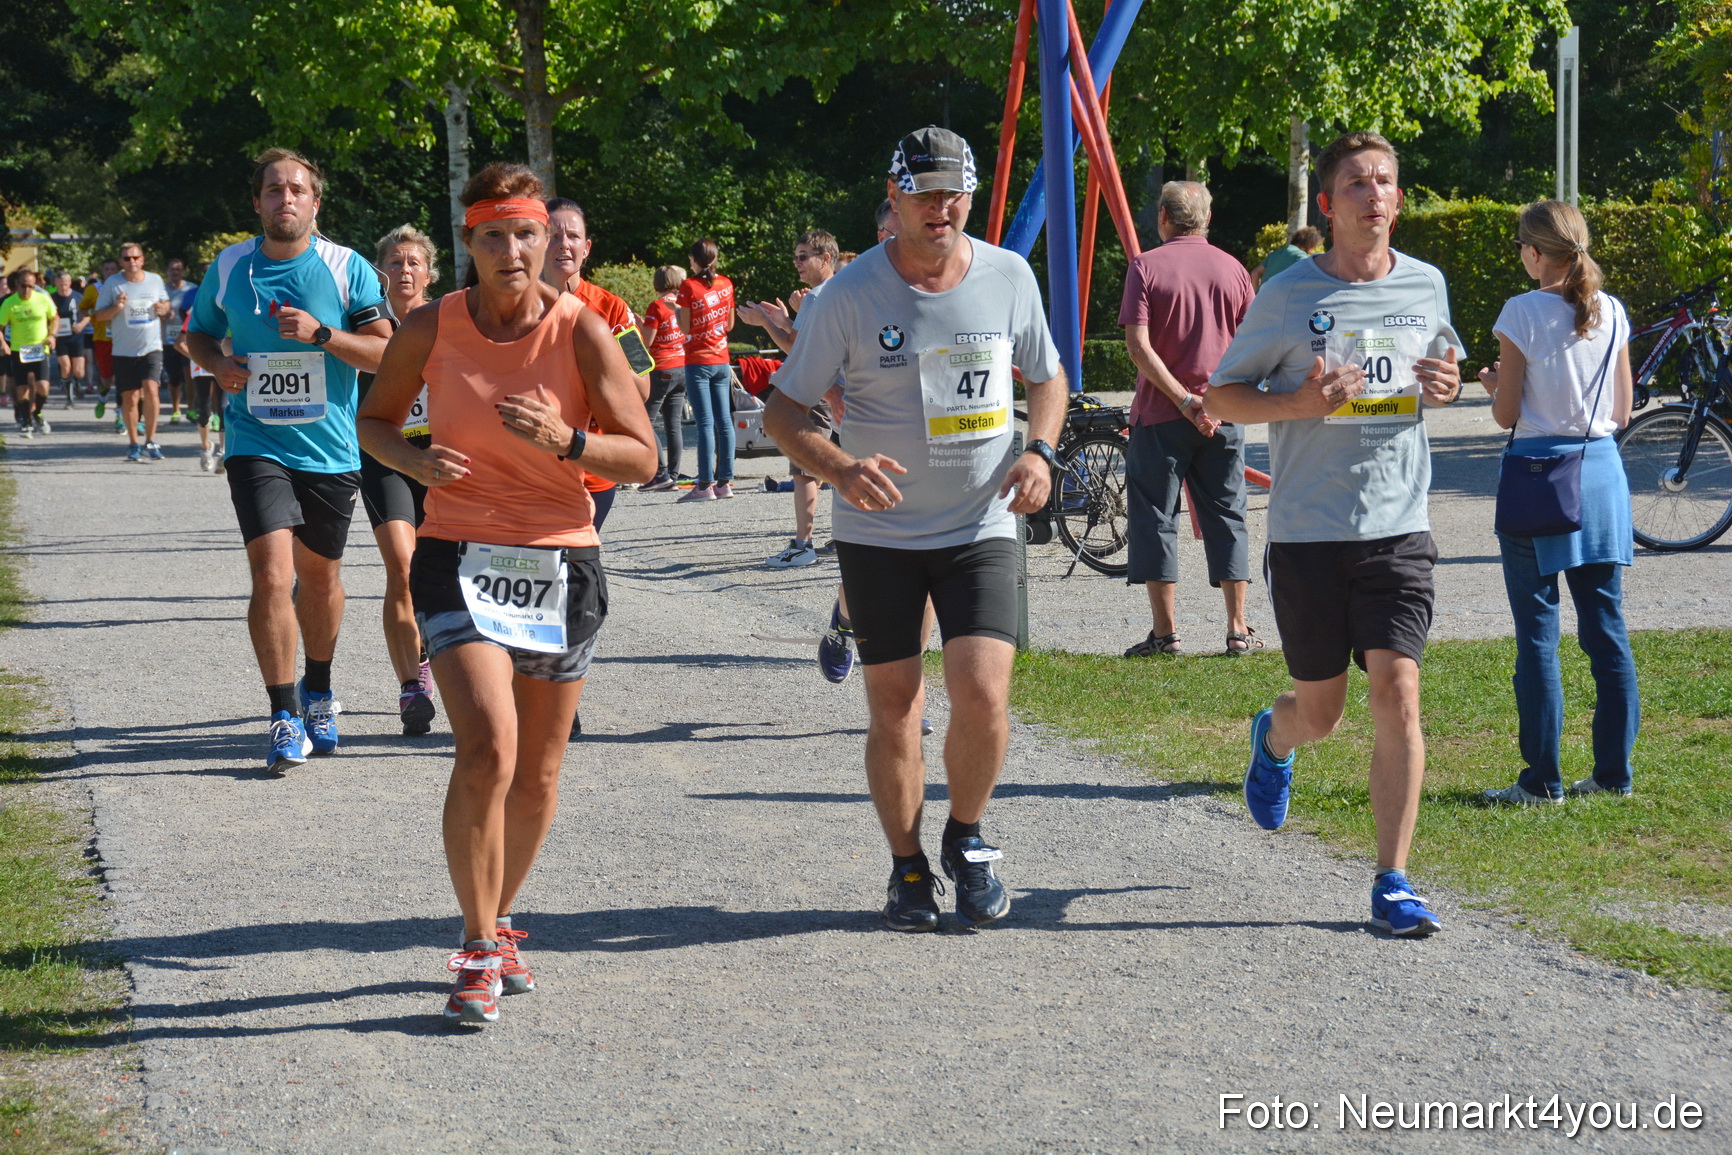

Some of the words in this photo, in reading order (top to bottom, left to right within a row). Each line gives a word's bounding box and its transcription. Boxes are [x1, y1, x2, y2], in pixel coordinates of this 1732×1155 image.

[1383, 315, 1427, 327] BOCK
[955, 332, 1001, 344] BOCK
[1356, 338, 1395, 348] BOCK
[268, 359, 301, 367] BOCK
[880, 355, 907, 363] PARTL
[950, 351, 992, 364] BOCK
[1363, 356, 1392, 384] 40
[259, 373, 310, 395] 2091
[957, 370, 990, 399] 47
[969, 402, 995, 410] Neumarkt
[1351, 401, 1399, 415] Yevgeniy
[269, 408, 305, 417] Markus
[959, 416, 994, 430] Stefan
[929, 445, 989, 456] Neumarkter
[928, 458, 977, 468] Stadtlauf
[491, 555, 539, 570] BOCK
[472, 575, 552, 609] 2097
